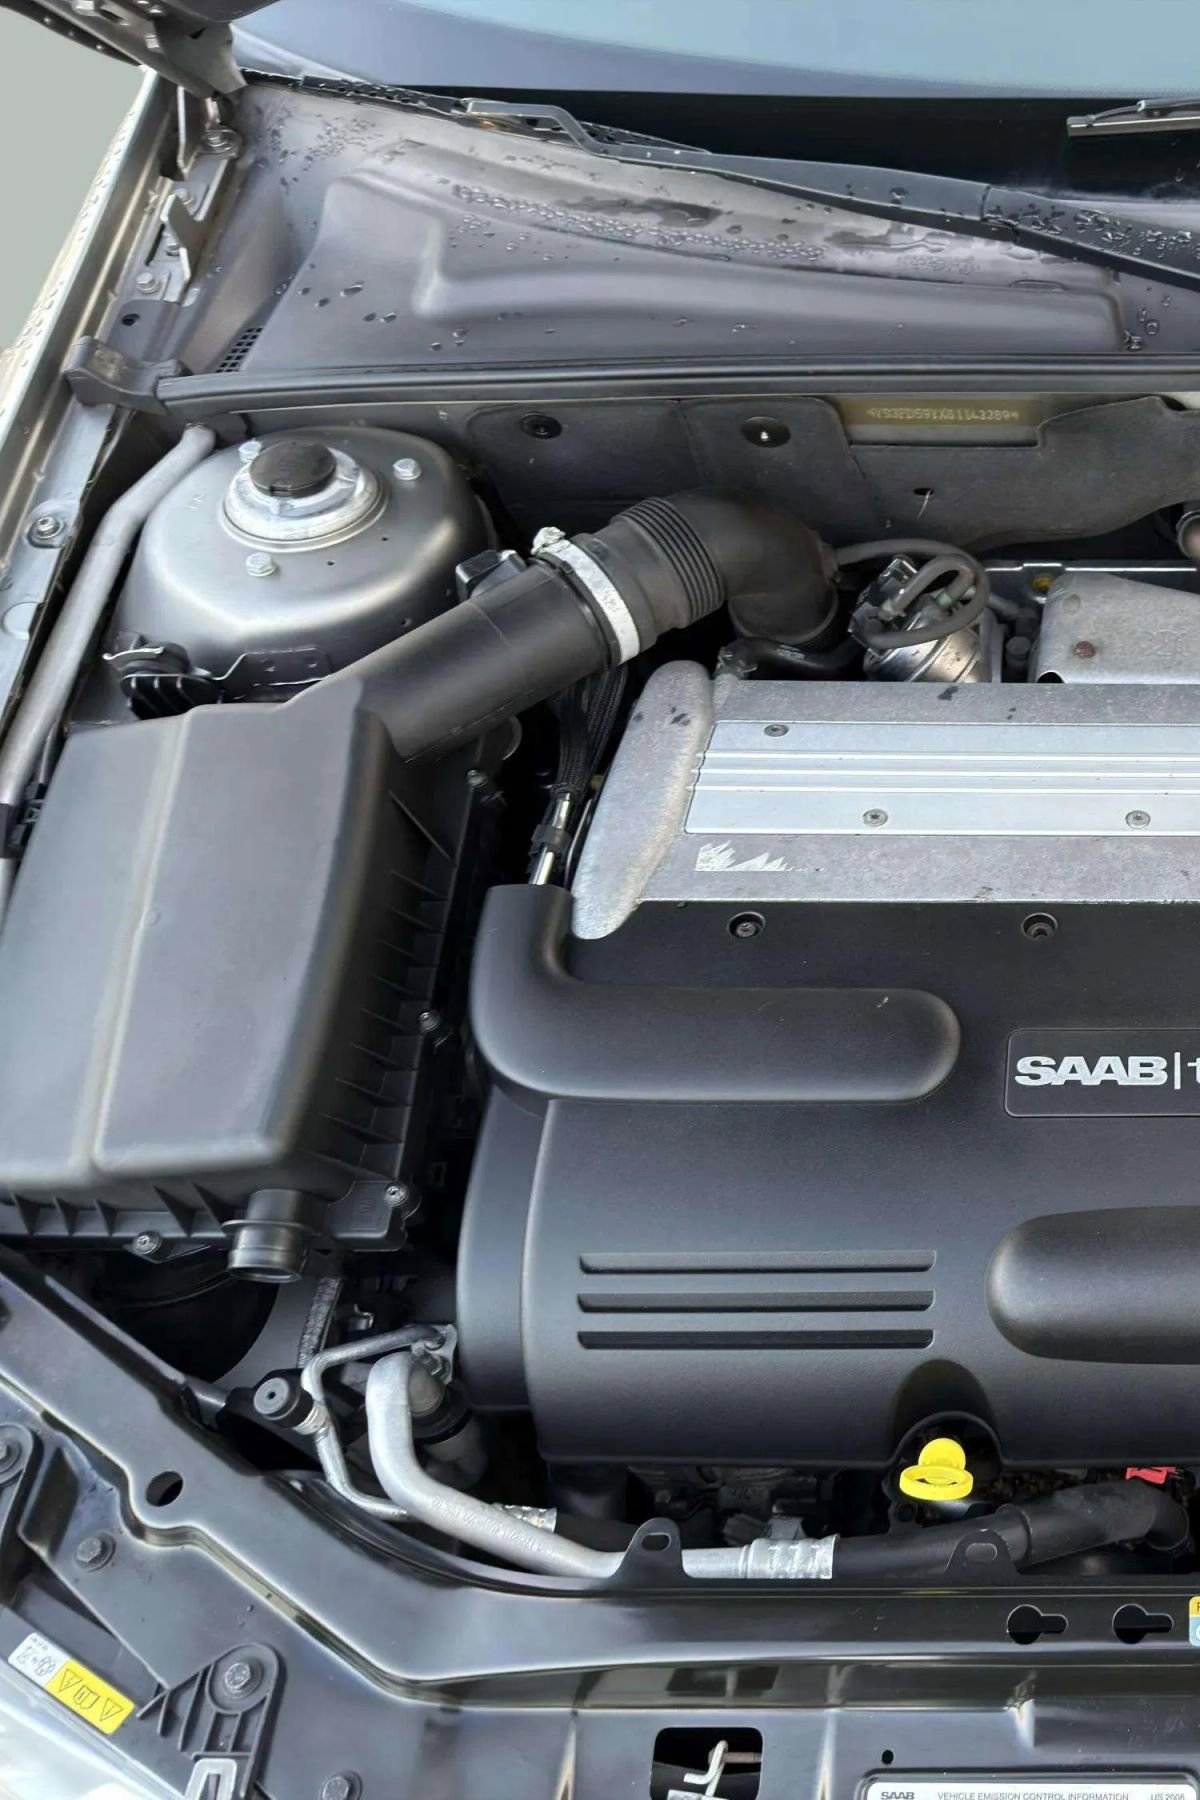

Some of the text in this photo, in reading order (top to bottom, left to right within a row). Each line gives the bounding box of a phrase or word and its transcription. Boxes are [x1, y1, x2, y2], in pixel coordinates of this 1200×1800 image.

[1014, 1055, 1169, 1086] SAAB
[880, 1791, 916, 1800] SAAB
[937, 1791, 976, 1800] VEHICLE
[978, 1791, 1021, 1800] EMISSION
[1023, 1791, 1065, 1800] CONTROL
[1068, 1792, 1129, 1800] INFORMATION
